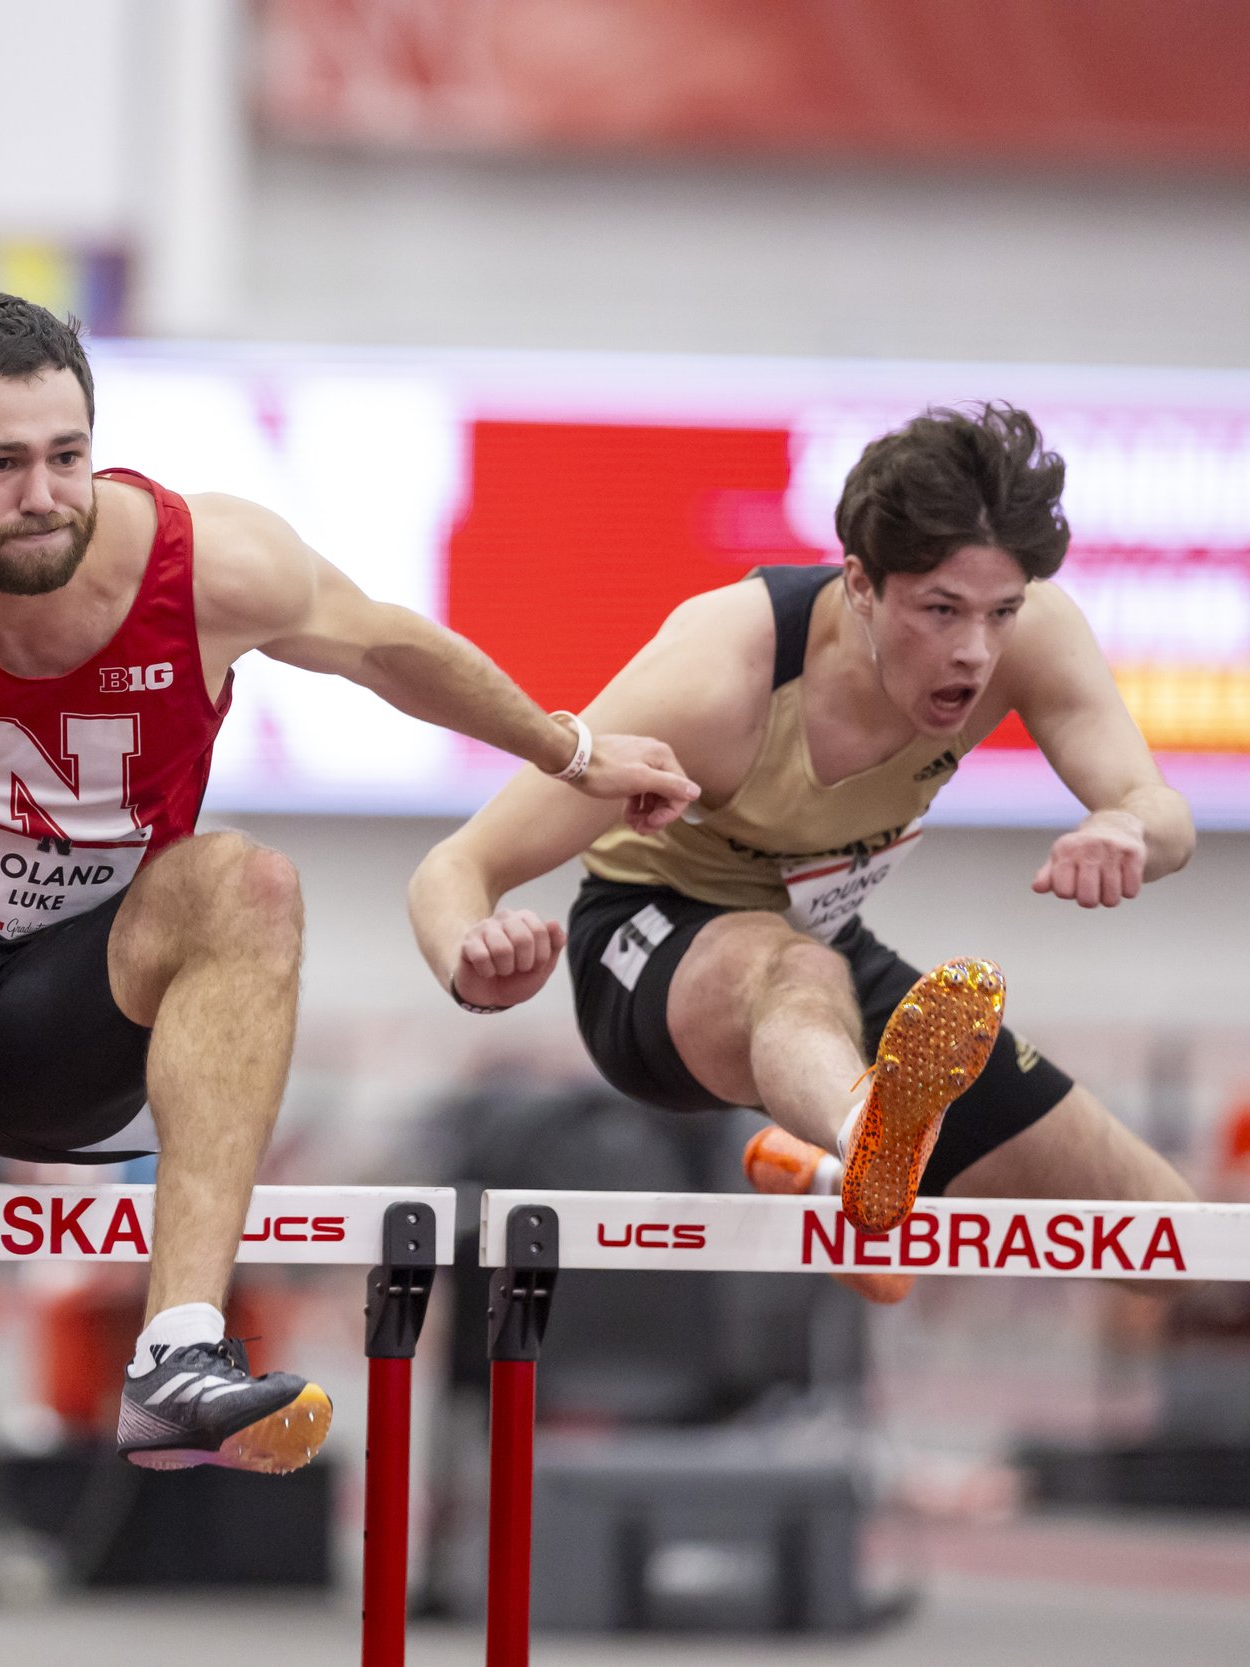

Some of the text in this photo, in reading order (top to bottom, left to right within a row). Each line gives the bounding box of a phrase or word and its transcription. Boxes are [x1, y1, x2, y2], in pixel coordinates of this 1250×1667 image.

[7, 889, 65, 911] LUKE
[809, 863, 892, 915] YOUNG
[599, 1225, 704, 1248] UCS
